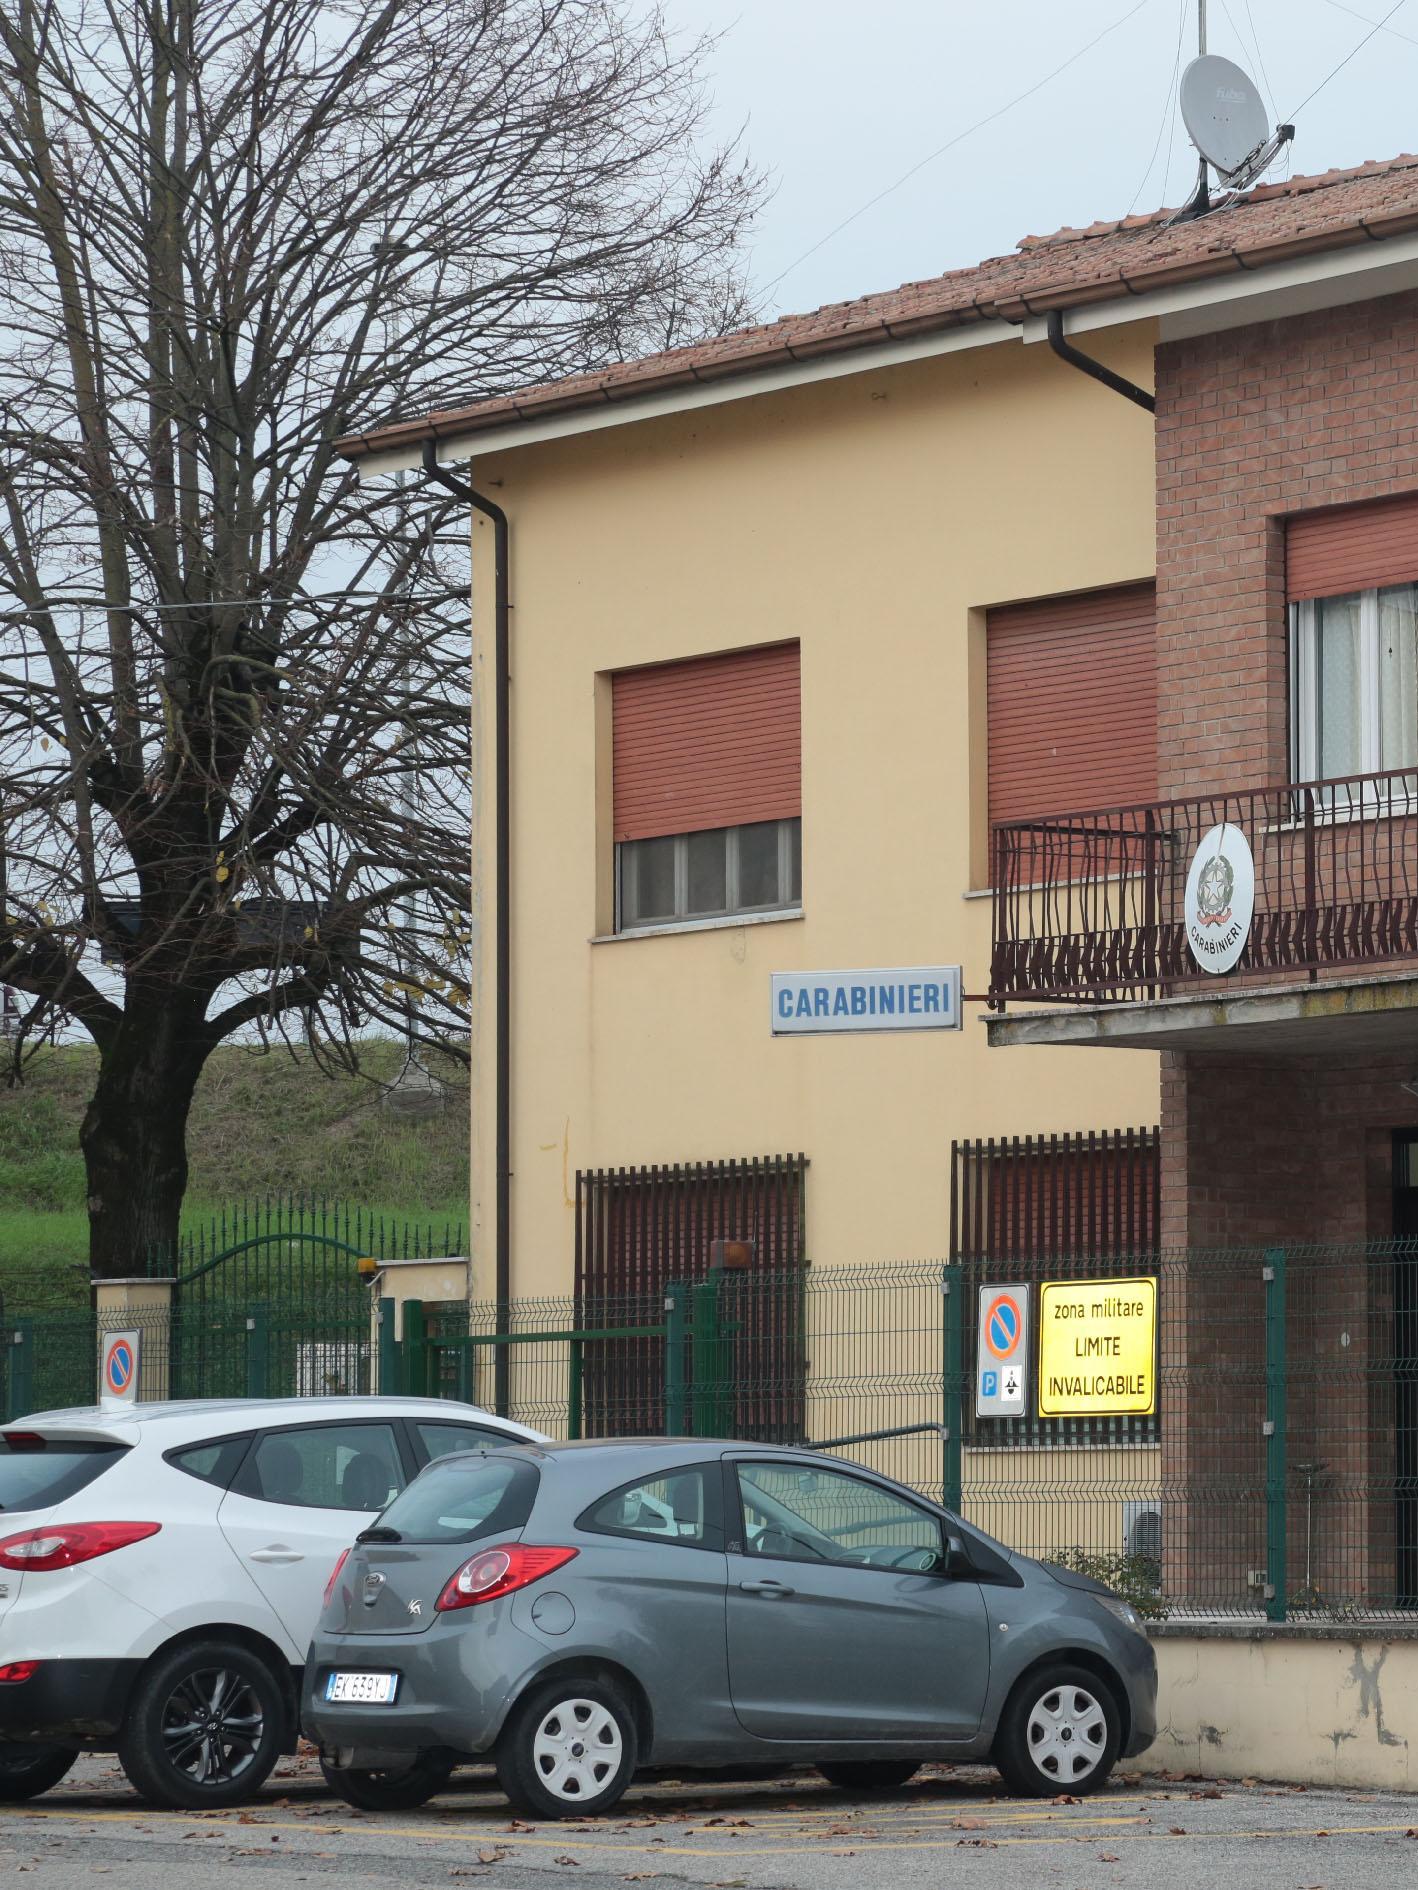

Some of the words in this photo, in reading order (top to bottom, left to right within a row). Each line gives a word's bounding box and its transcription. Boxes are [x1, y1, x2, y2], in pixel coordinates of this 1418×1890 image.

[1191, 921, 1243, 955] CARABINIERI
[778, 983, 950, 1018] CARABINIERI
[1054, 1303, 1085, 1320] zona
[1091, 1297, 1144, 1319] militare
[1075, 1336, 1121, 1357] LIMITE
[985, 1374, 994, 1393] P
[1049, 1374, 1146, 1397] INVALICABILE
